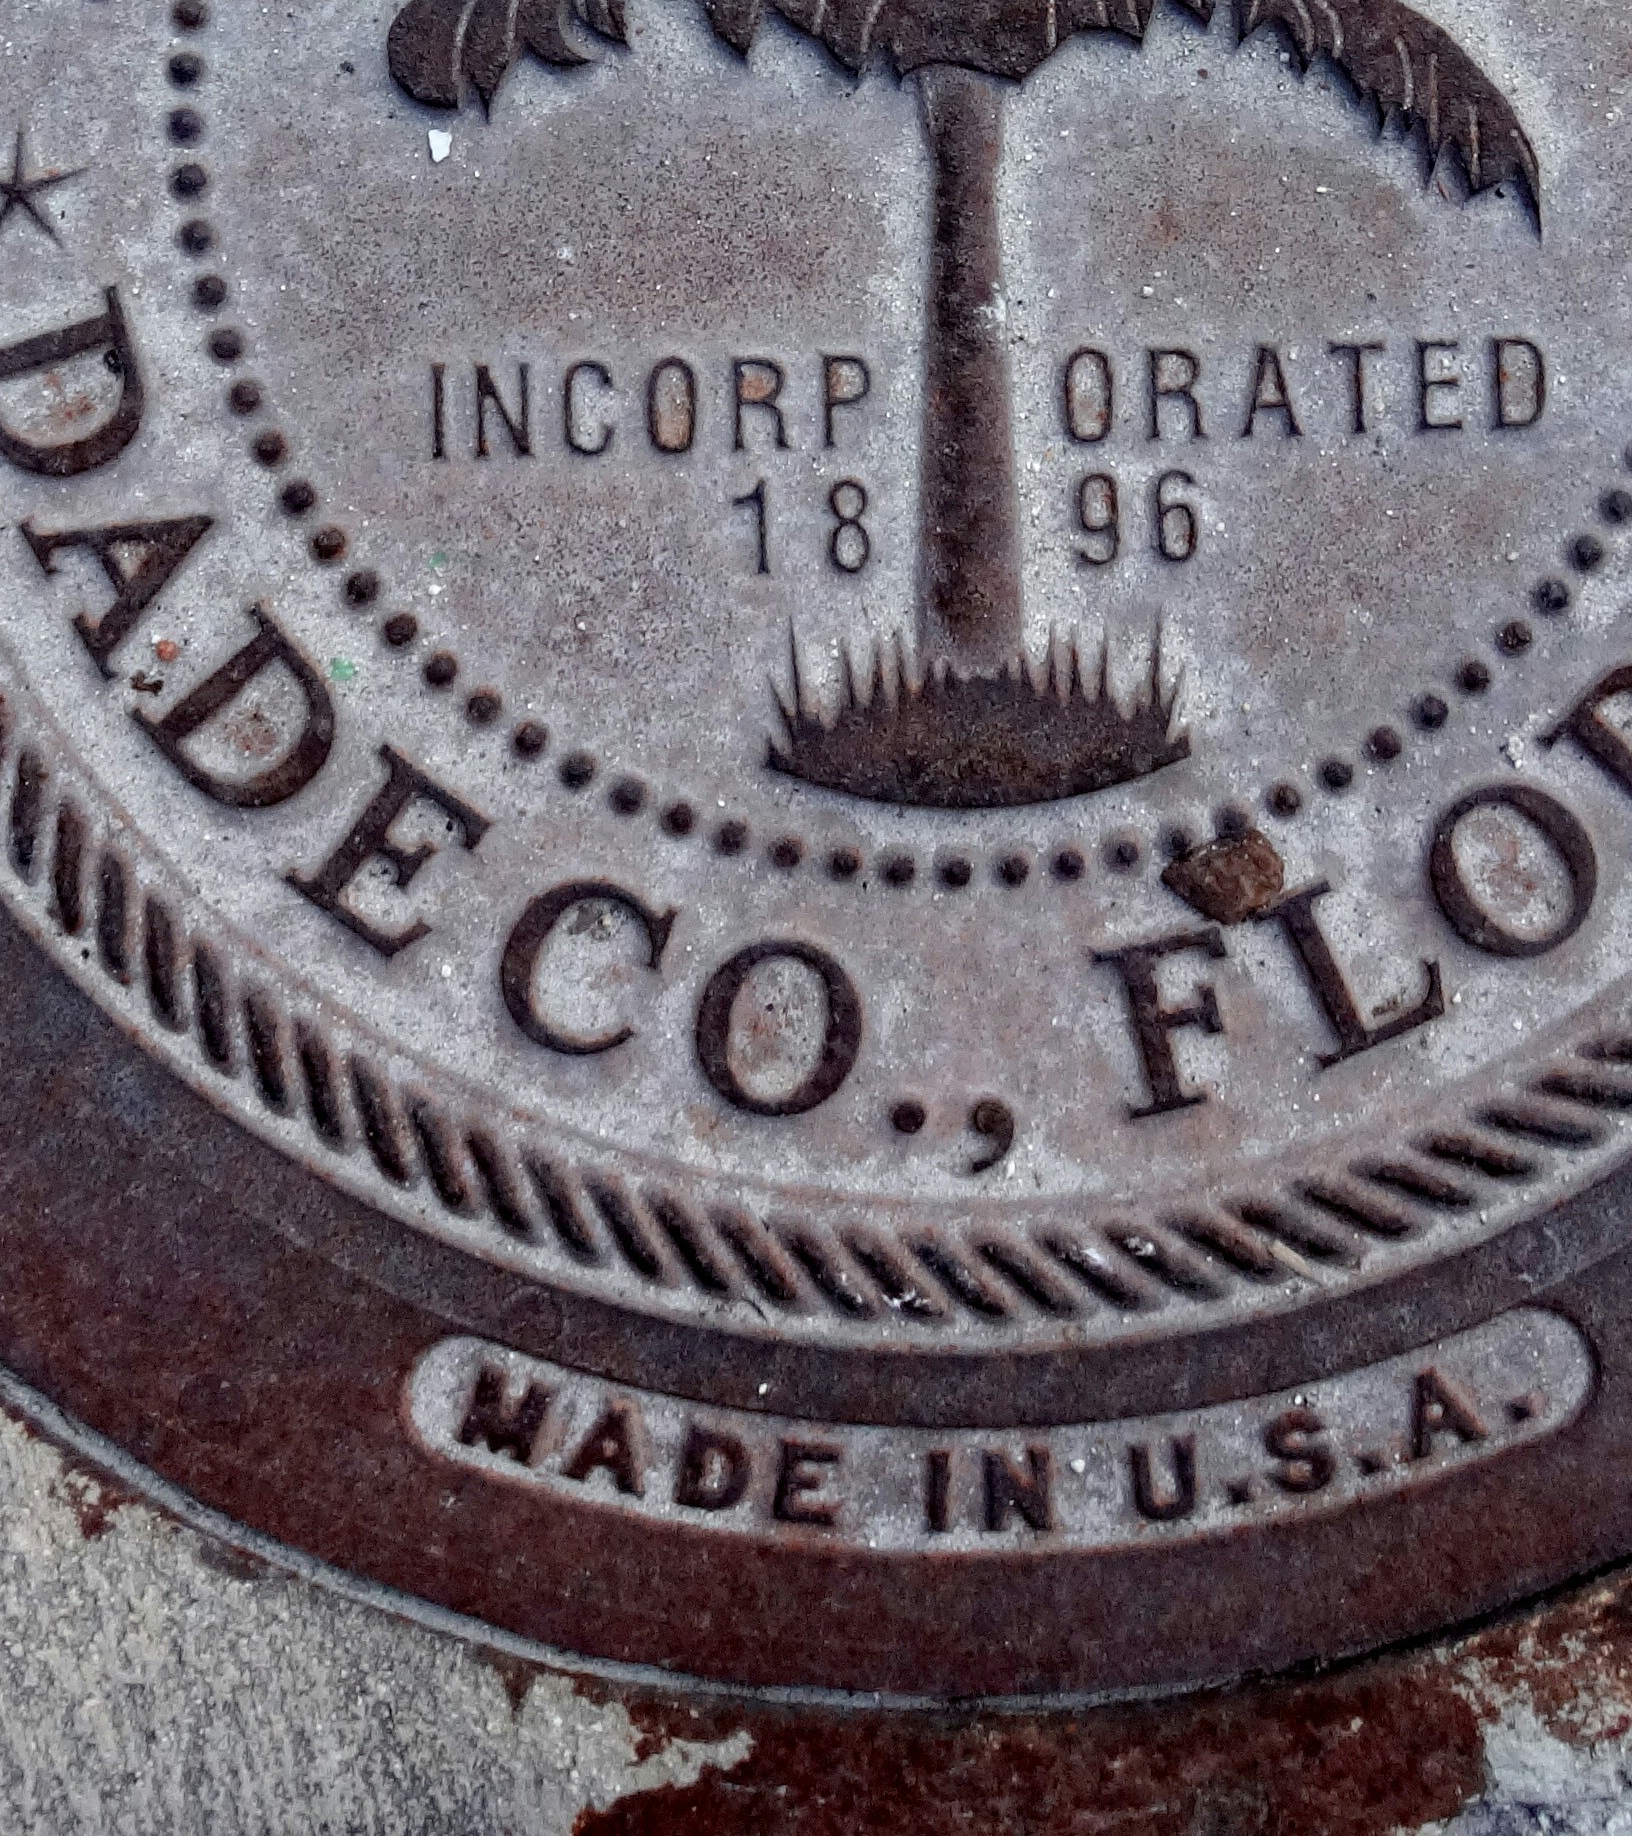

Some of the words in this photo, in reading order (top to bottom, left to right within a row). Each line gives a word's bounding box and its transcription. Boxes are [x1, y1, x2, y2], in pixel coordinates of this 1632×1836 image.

[426, 353, 874, 462] INCORP
[1062, 335, 1549, 446] ORATED
[731, 477, 872, 576] 18
[1075, 468, 1199, 568] 96
[454, 1361, 845, 1527] MADE
[924, 1441, 1053, 1534] IN
[1129, 1366, 1534, 1521] U.S.A.
